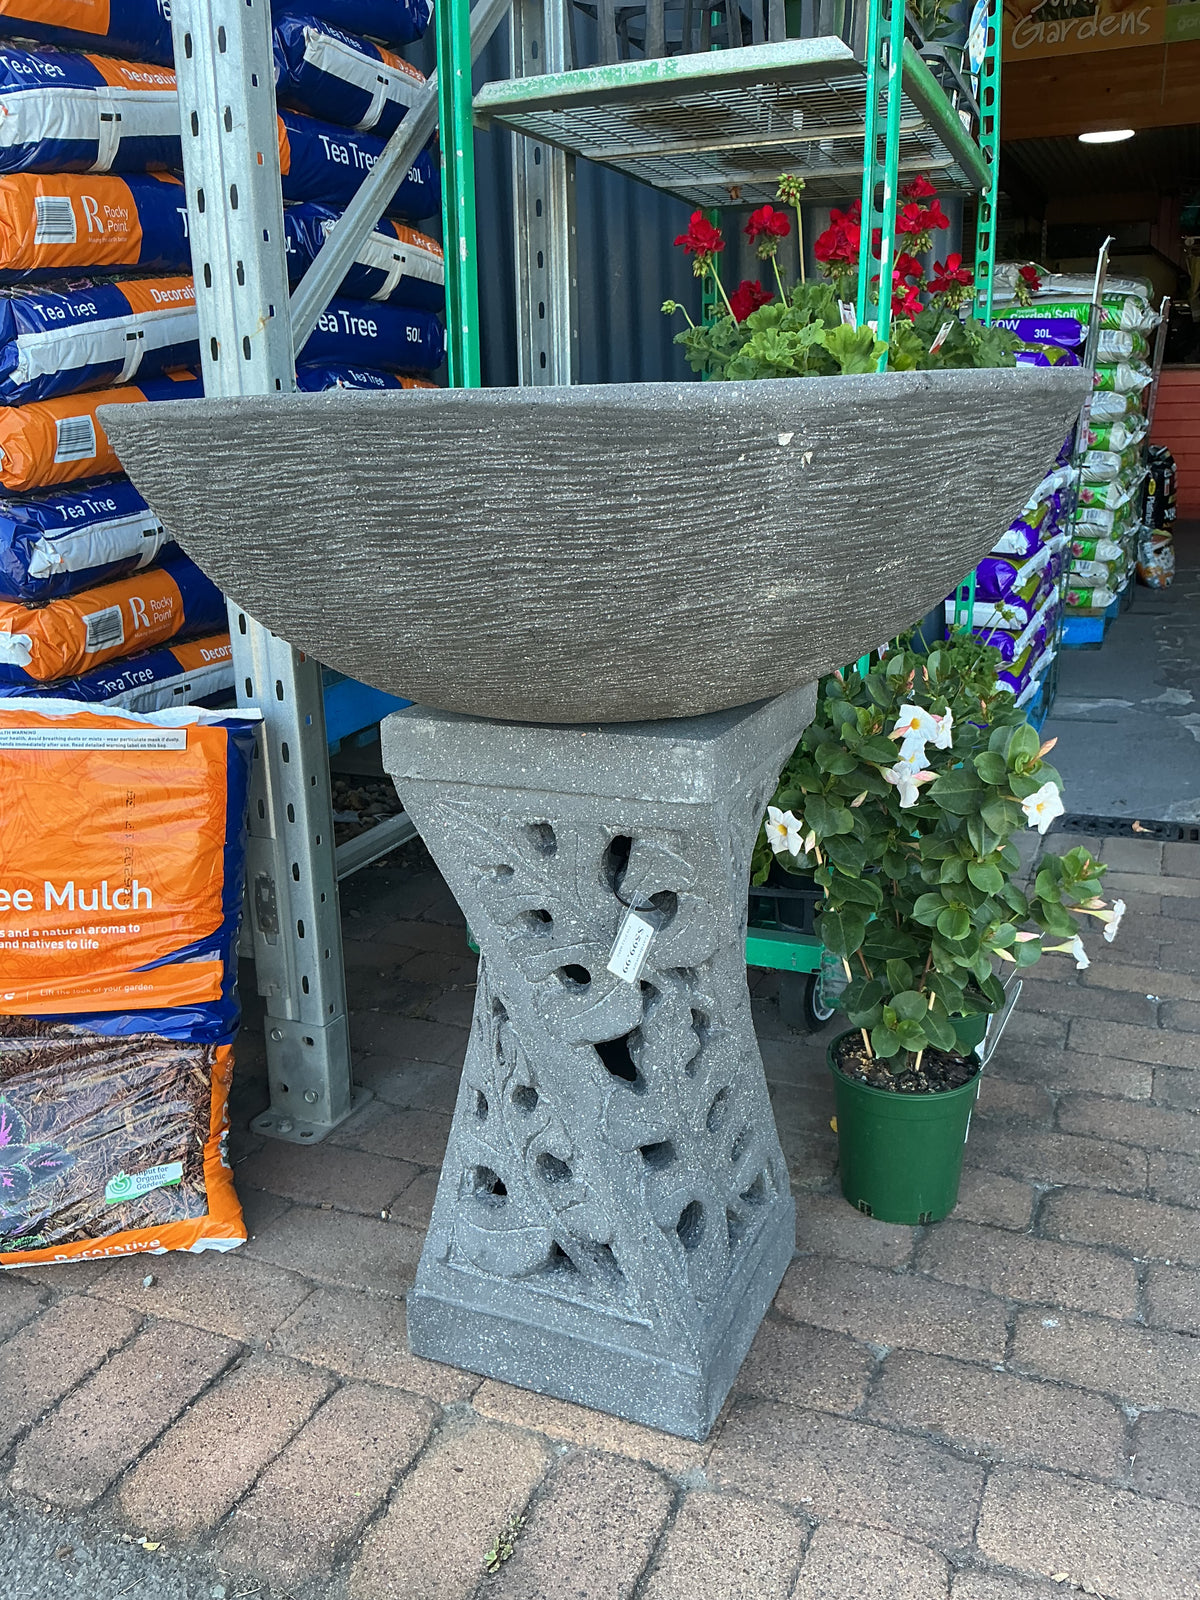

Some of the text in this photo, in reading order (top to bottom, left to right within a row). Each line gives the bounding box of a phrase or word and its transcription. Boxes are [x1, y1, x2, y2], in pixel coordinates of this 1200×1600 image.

[1011, 6, 1151, 50] Gardens
[0, 56, 66, 77] Tea Tree
[318, 134, 350, 165] Tea
[104, 205, 129, 220] Rocky
[107, 219, 128, 233] Point
[33, 301, 98, 322] Tea Tree
[313, 310, 423, 343] ea Tree 50L
[1033, 329, 1053, 339] 30L
[348, 370, 385, 387] Tea Tree
[56, 498, 118, 521] Tea Tree
[150, 595, 173, 611] Rocky
[153, 609, 173, 624] Point
[98, 668, 155, 694] Tea Tree
[0, 879, 153, 912] ee Mulch
[8, 928, 30, 938] and
[42, 926, 87, 937] natural
[88, 924, 127, 935] aroma
[129, 923, 141, 934] to
[0, 938, 100, 950] and natives to life
[40, 988, 54, 997] Lift
[103, 986, 122, 994] your
[124, 983, 154, 994] garden
[157, 1165, 169, 1173] for
[136, 1173, 166, 1184] Organic
[54, 1238, 161, 1262] Dcorative
